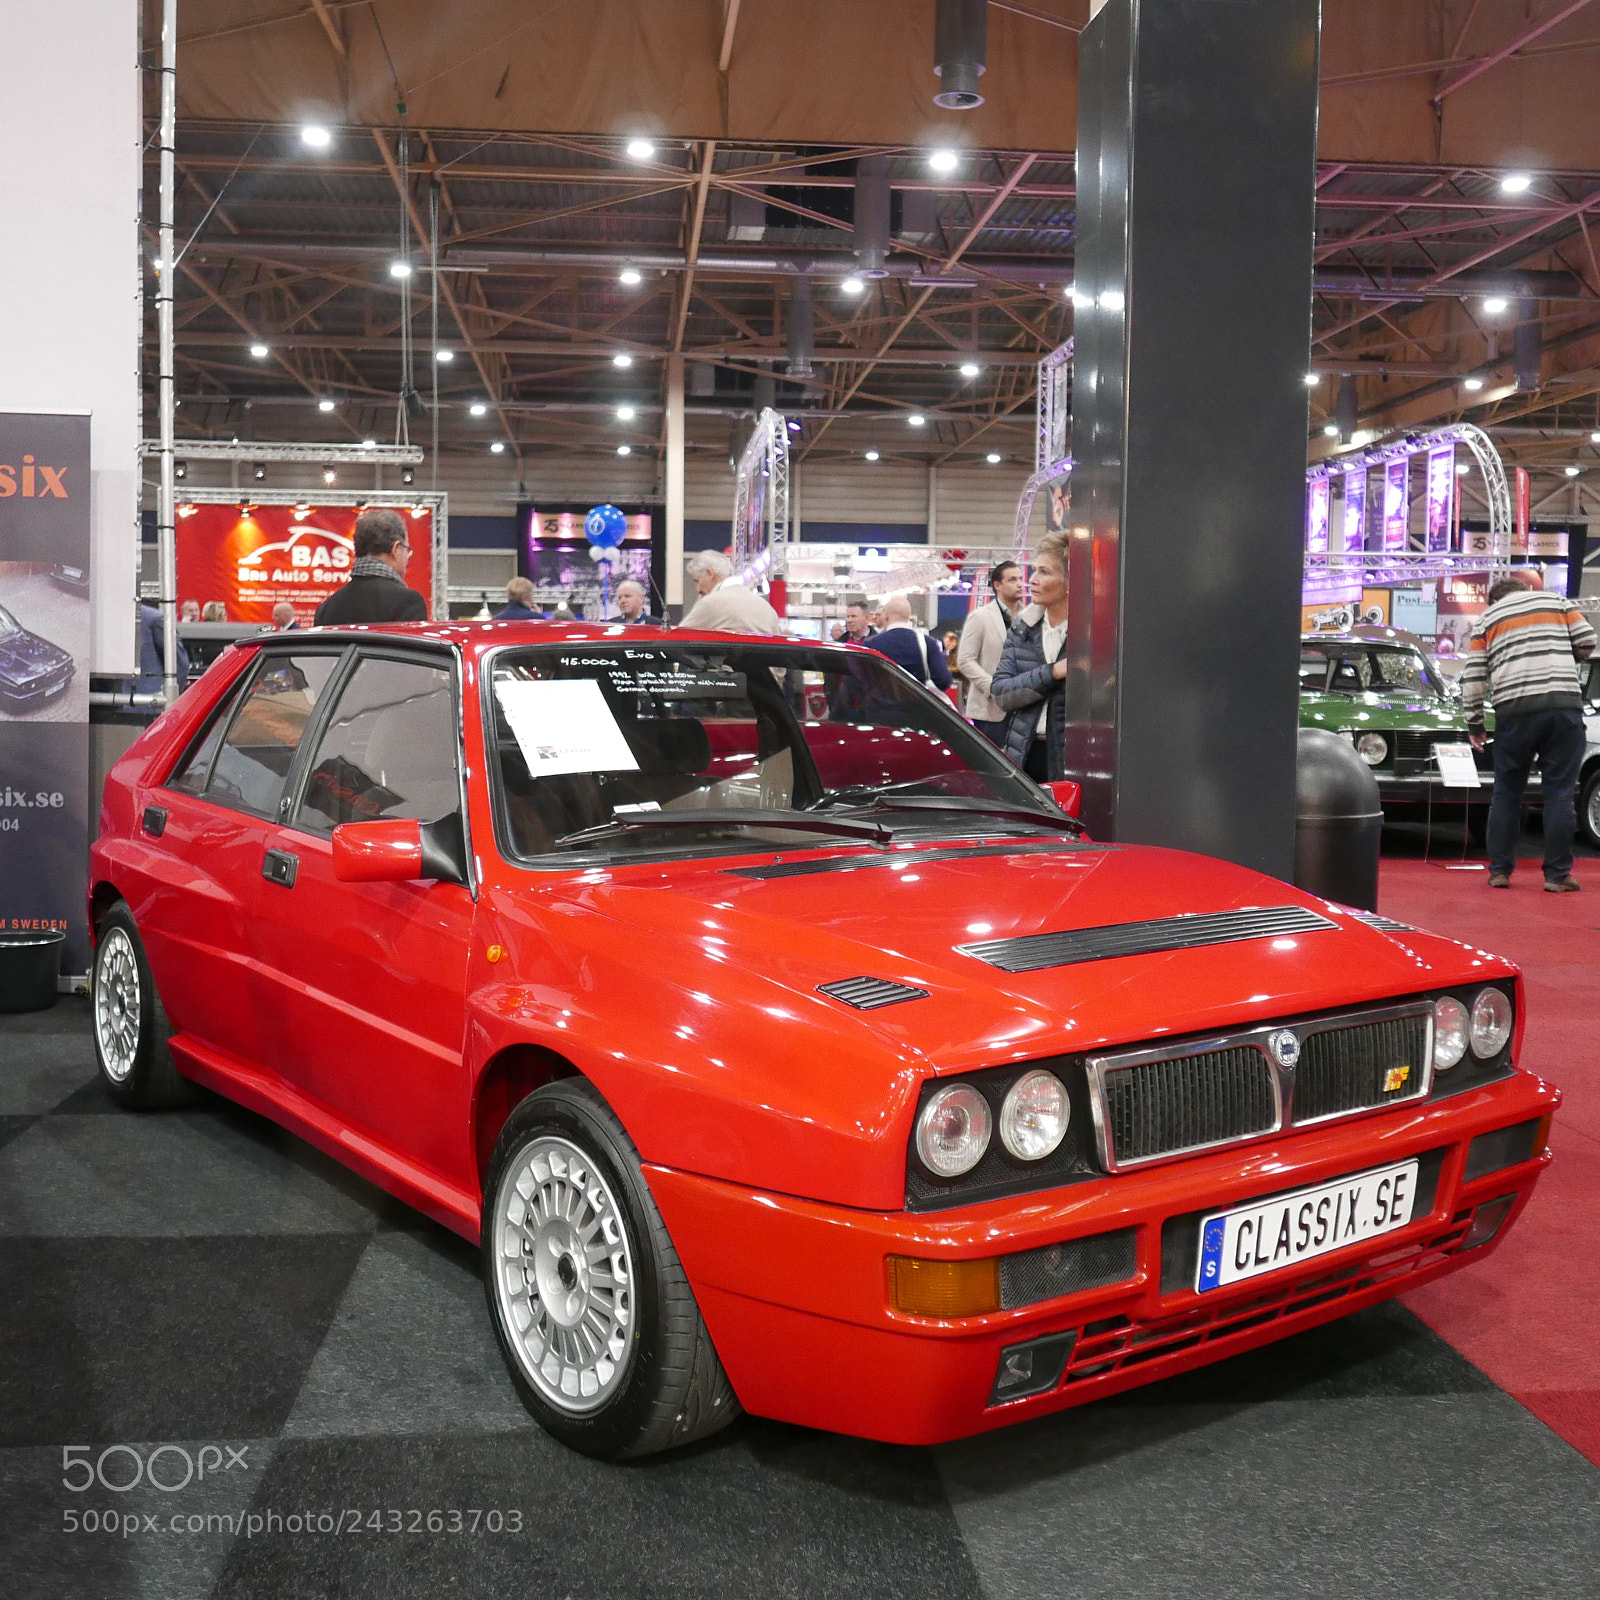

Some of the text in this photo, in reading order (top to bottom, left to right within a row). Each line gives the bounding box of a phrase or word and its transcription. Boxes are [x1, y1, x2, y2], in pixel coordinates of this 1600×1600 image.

[1473, 537, 1487, 551] 25
[291, 545, 350, 568] BAS
[238, 567, 268, 582] Bas
[272, 568, 309, 582] Auto
[624, 650, 655, 659] Evo
[0, 818, 20, 831] 04
[12, 919, 67, 930] SWEDEN
[1205, 1173, 1408, 1278] S CLASSIX.SE
